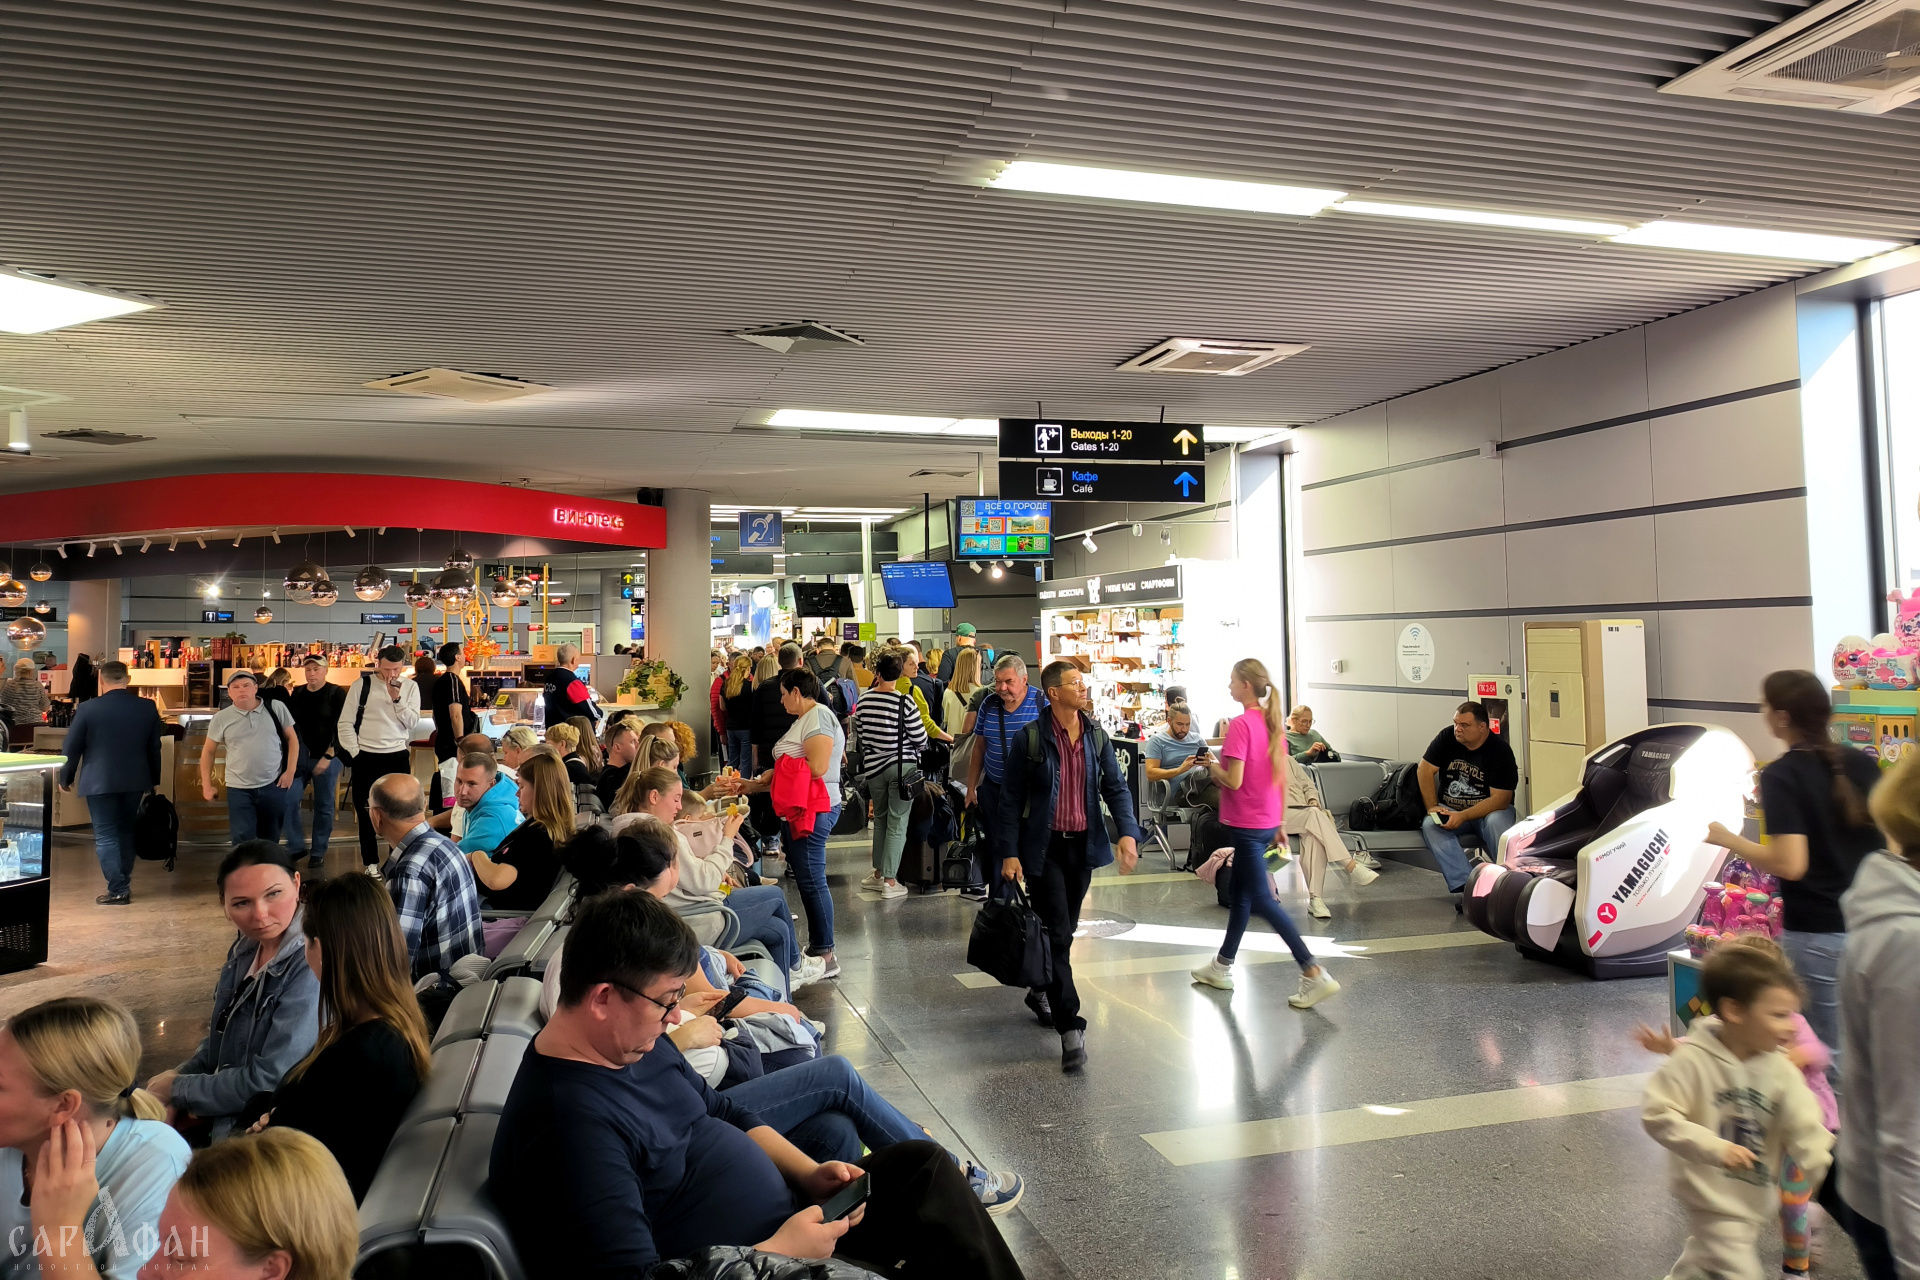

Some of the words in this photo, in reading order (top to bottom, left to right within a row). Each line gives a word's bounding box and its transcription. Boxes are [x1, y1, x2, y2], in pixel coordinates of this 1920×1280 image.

[1070, 428, 1110, 441] Выходы
[1111, 429, 1133, 440] 1-20
[1070, 441, 1097, 451] Gates
[1099, 442, 1120, 452] 1-20
[1071, 471, 1099, 483] Кафе
[1072, 483, 1093, 493] Café
[1004, 502, 1011, 510] О
[1013, 502, 1048, 511] ГОРОДЕ
[1121, 581, 1136, 592] ЧАСЫ
[1140, 577, 1175, 590] СМАРТФОНЫ
[1478, 684, 1486, 693] ПК
[1641, 750, 1671, 760] YAMAGUCHI
[1446, 761, 1485, 782] MOTORCYCLE
[1611, 828, 1670, 904] YAMAGUCHI
[1632, 875, 1650, 898] ТОЛЬКО
